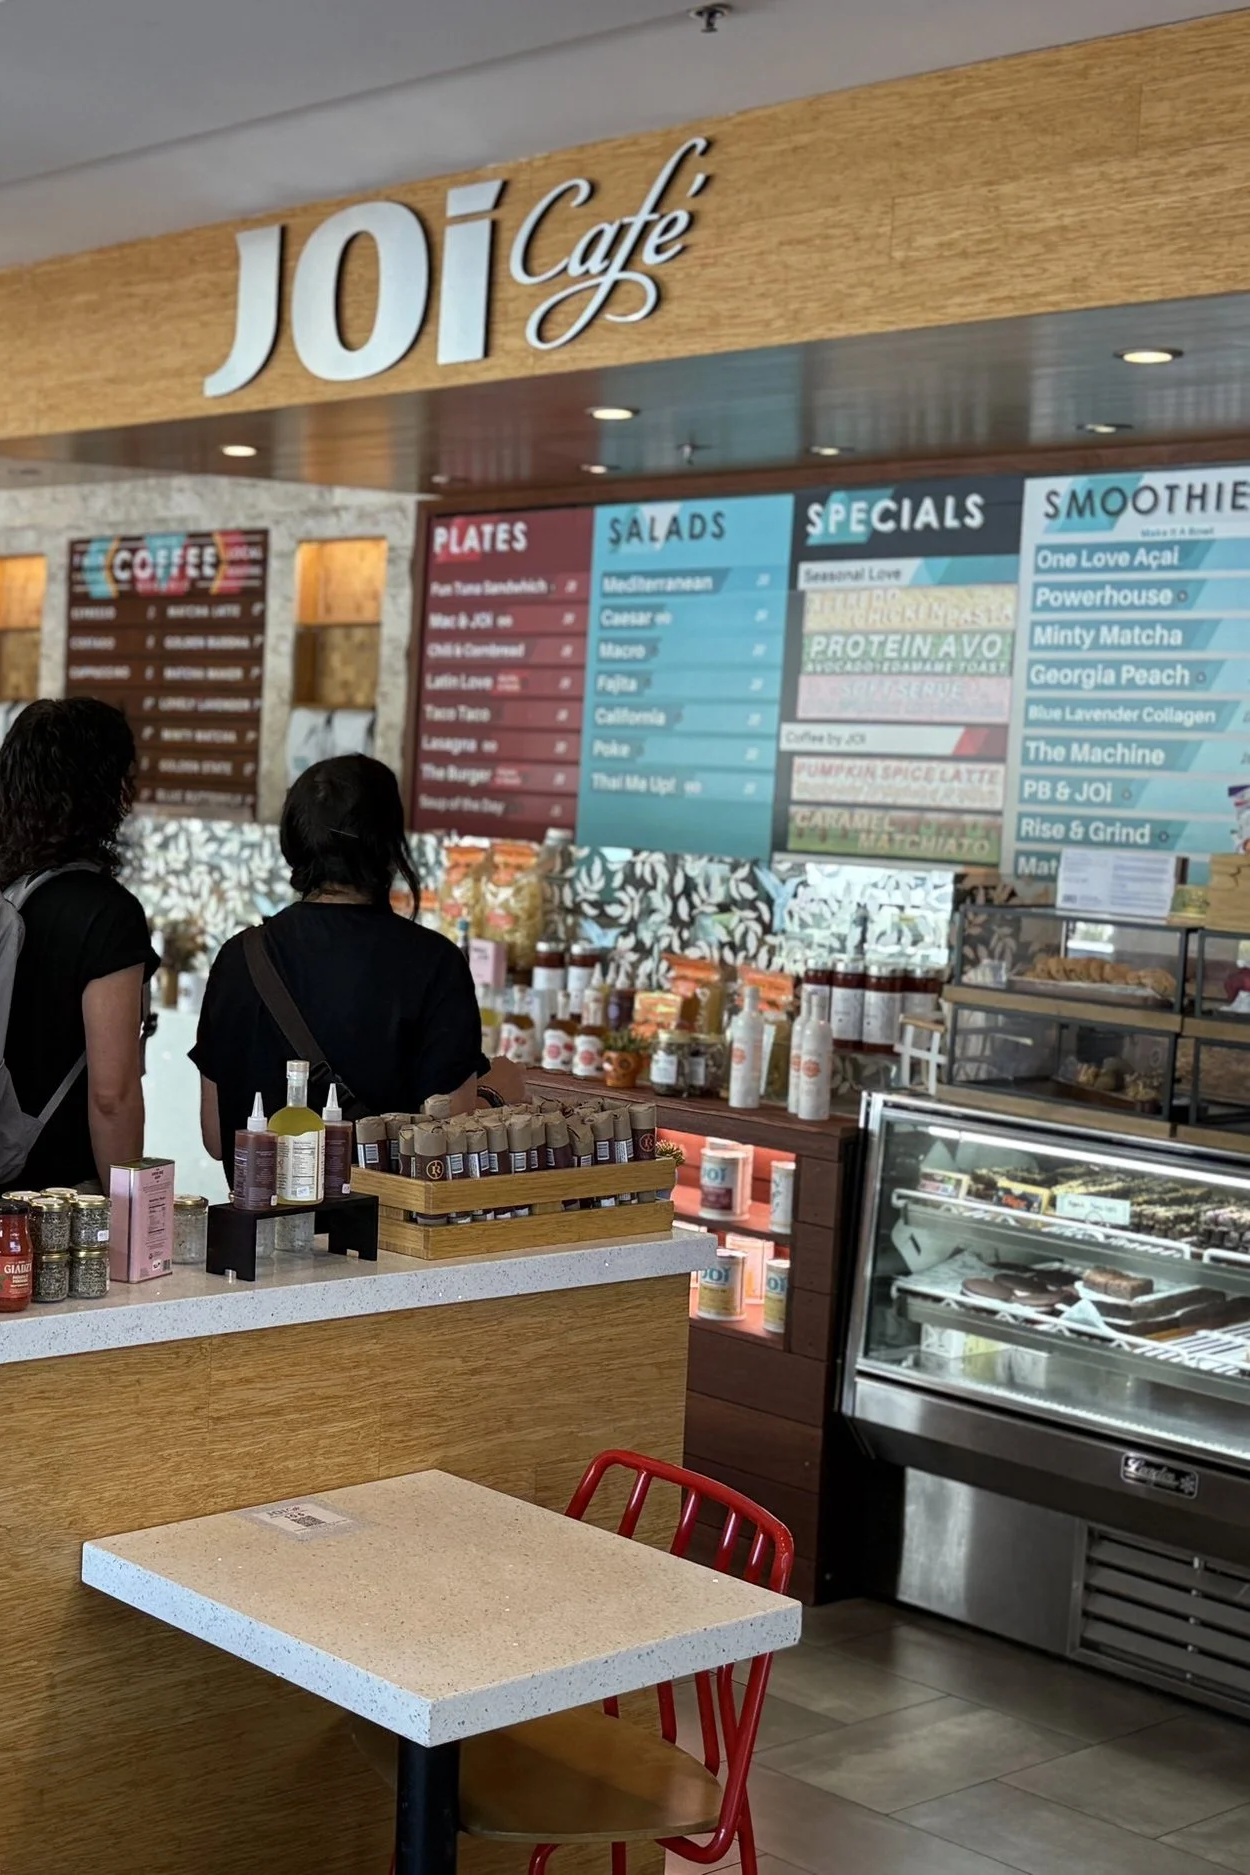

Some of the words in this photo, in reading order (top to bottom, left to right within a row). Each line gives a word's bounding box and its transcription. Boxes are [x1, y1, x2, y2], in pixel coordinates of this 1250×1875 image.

[509, 136, 709, 350] Café
[806, 493, 985, 536] SPECIALS
[433, 522, 528, 554] PLATES
[609, 511, 726, 546] SALADS
[113, 546, 216, 581] COFFEE
[1037, 550, 1077, 569] One
[1081, 549, 1130, 568] Love
[602, 574, 713, 594] Mediterranean
[804, 567, 865, 583] Seasonal
[869, 567, 902, 581] Love
[1035, 585, 1173, 607] Powerhouse
[600, 609, 653, 627] Caesar
[809, 632, 932, 659] PROTEIN
[938, 633, 1001, 659] AVO
[1033, 625, 1095, 649] Minty
[1099, 623, 1183, 646] Matcha
[599, 641, 647, 660] Macro
[424, 672, 459, 690] Latin
[460, 673, 494, 691] Love
[596, 673, 638, 696] Fajita
[1030, 662, 1116, 690] Georgia
[1120, 663, 1189, 686] Peach
[423, 704, 457, 722] Taco
[457, 704, 491, 723] Taco
[594, 706, 667, 727] California
[1027, 704, 1063, 721] Blue
[1065, 706, 1139, 723] Lavender
[1142, 707, 1216, 726] Collagen
[421, 734, 478, 756] Lasagna
[592, 739, 631, 758] Poke
[785, 731, 824, 744] Coffee
[826, 731, 842, 747] by
[1025, 740, 1065, 762] The
[1070, 741, 1165, 766] Machine
[793, 762, 877, 781] PUMPKIN
[877, 764, 936, 782] SPICE
[939, 766, 1001, 785] LATTE
[1023, 779, 1051, 799] PB
[1055, 781, 1071, 800] &
[795, 809, 895, 831] CARAMEL
[1020, 818, 1065, 839] Rise
[1069, 820, 1085, 841] &
[1088, 821, 1151, 845] Grind
